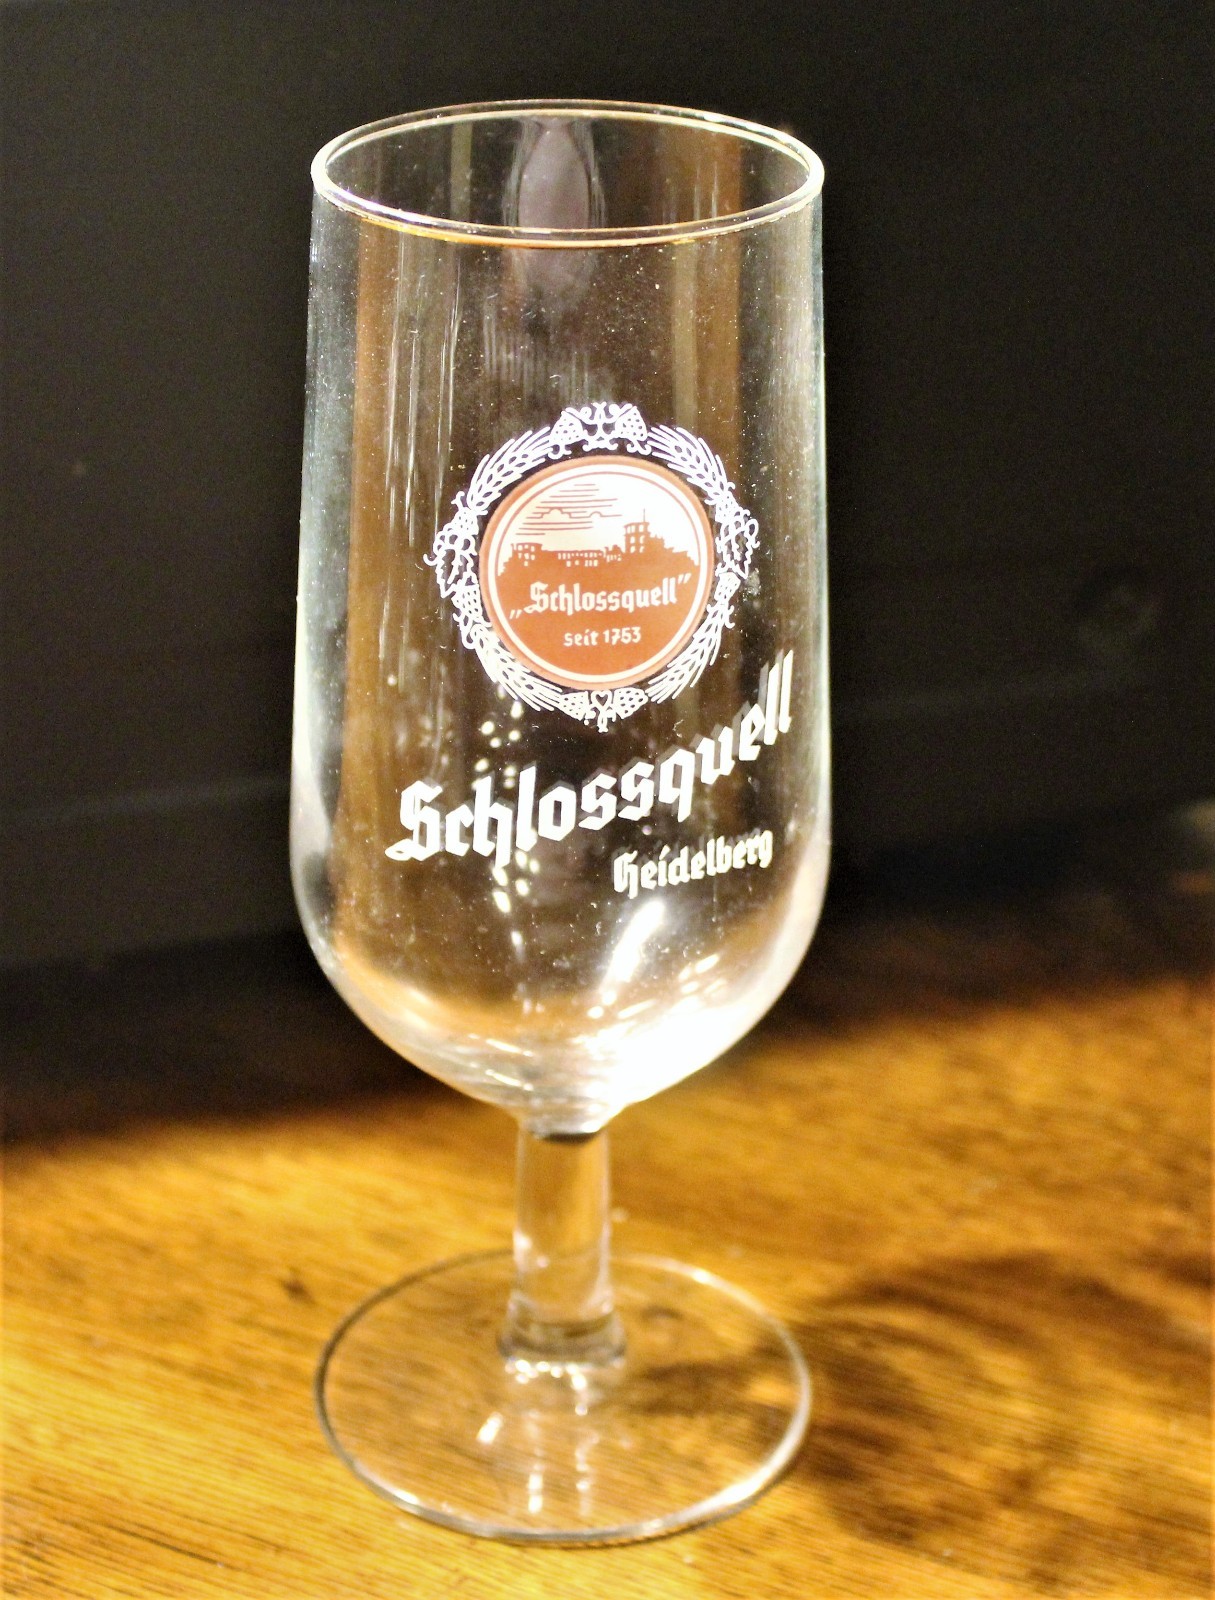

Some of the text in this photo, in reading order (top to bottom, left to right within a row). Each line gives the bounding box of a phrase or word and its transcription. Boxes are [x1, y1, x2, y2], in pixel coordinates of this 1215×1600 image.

[563, 629, 599, 647] seit
[384, 650, 793, 869] Schlossquell
[613, 829, 773, 900] Heidelberg
